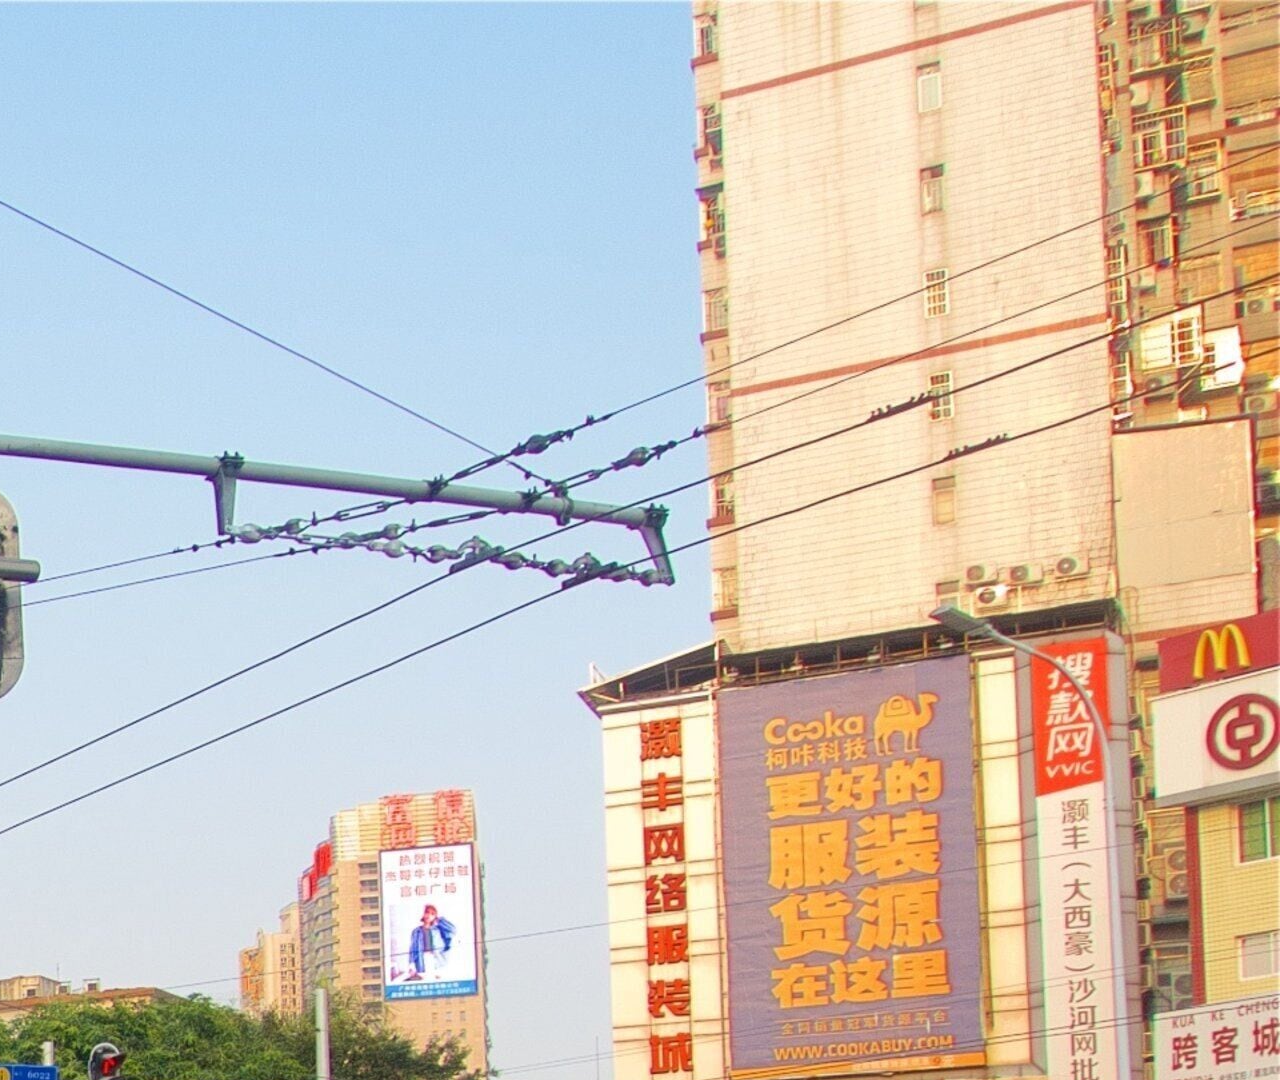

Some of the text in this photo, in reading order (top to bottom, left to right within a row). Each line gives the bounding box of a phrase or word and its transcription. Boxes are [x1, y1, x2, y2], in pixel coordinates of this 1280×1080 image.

[764, 711, 865, 746] Cooka
[1046, 652, 1095, 762] 搜款网
[766, 737, 868, 771] 柯咔科技
[1044, 760, 1096, 780] VVIC
[766, 757, 944, 820] 更好的
[768, 809, 942, 890] 服装
[640, 717, 694, 1075] 灏丰网络服装城
[769, 878, 943, 962] 货源
[771, 949, 952, 1010] 在这里
[773, 1034, 954, 1062] WWW.COOKABUY.COM
[1171, 1014, 1196, 1029] KUA
[1211, 1009, 1226, 1022] KE
[1171, 1017, 1280, 1072] 跨客城
